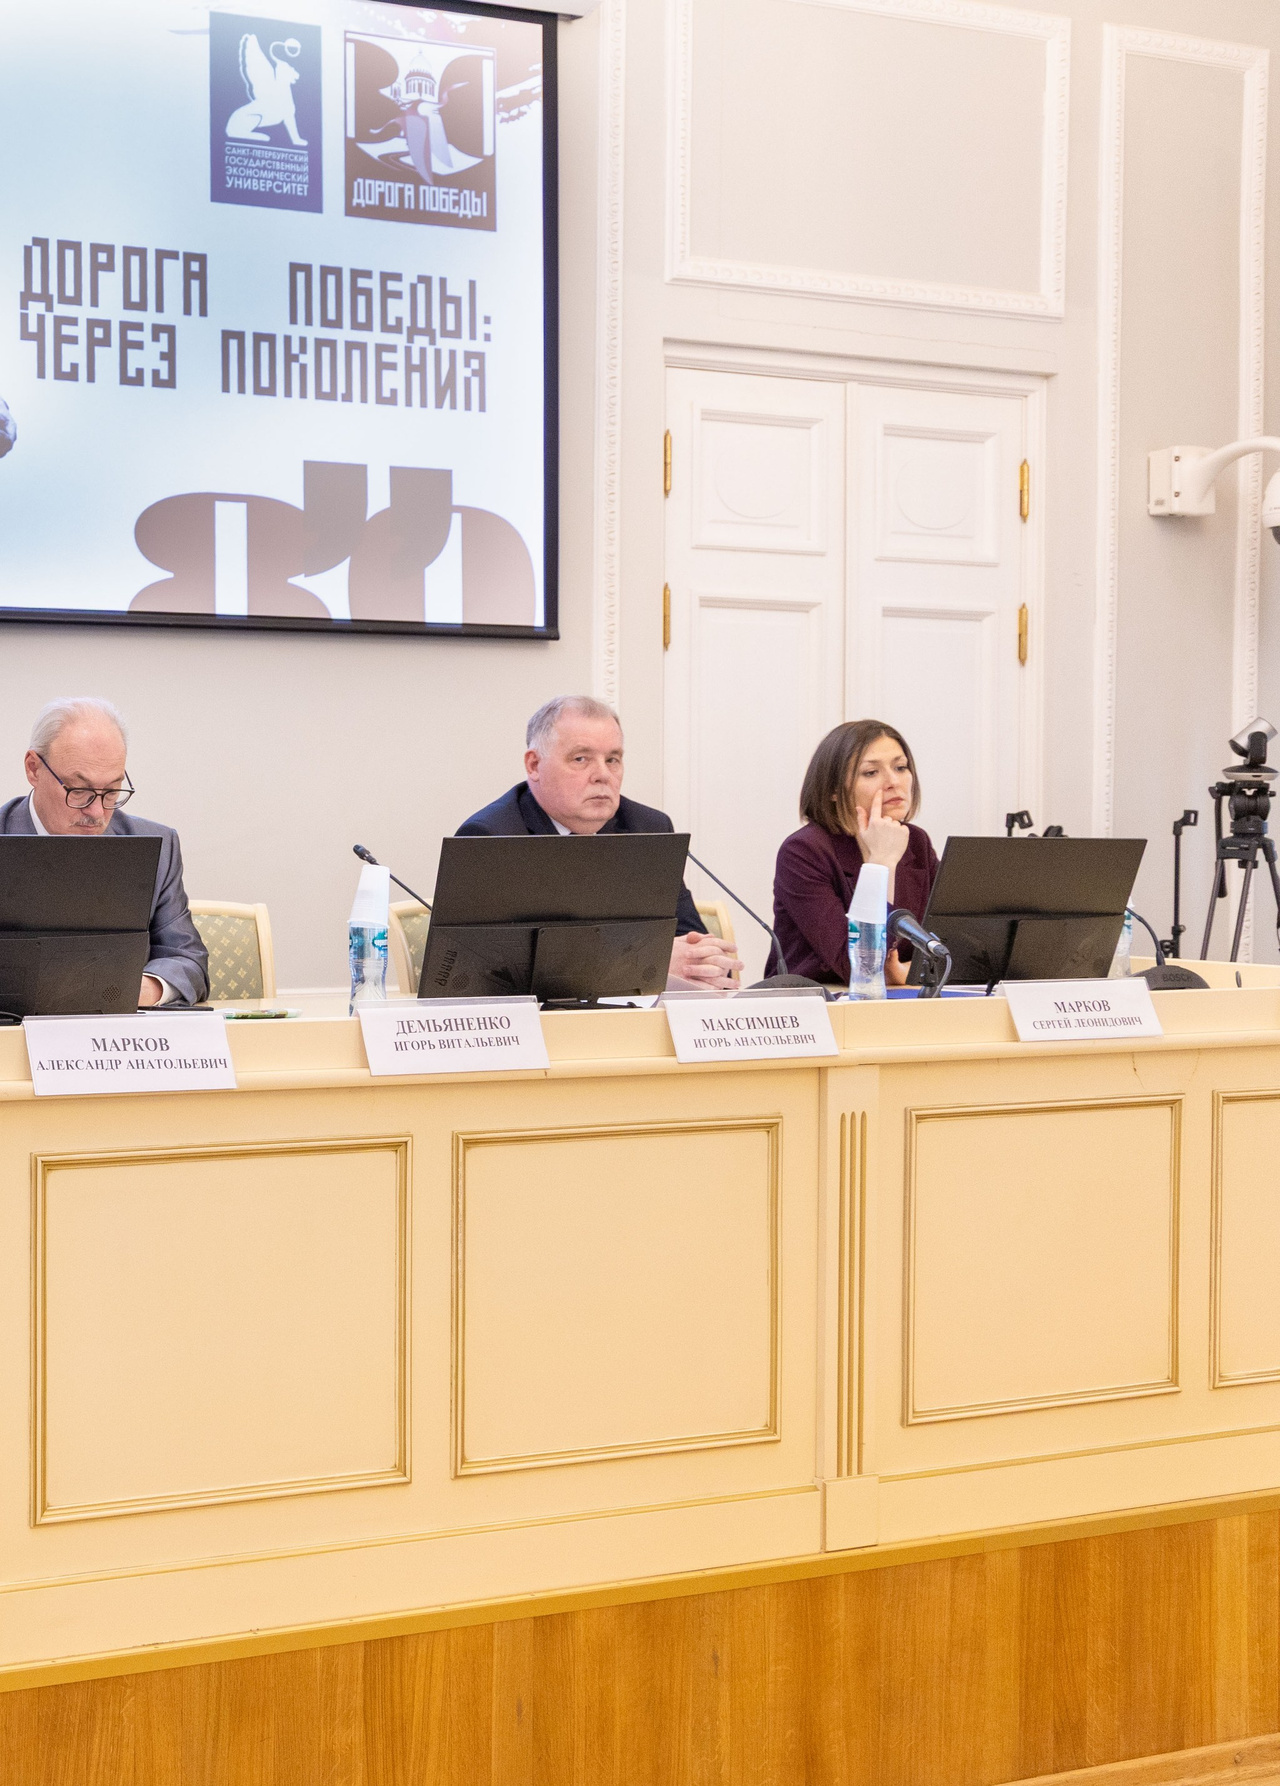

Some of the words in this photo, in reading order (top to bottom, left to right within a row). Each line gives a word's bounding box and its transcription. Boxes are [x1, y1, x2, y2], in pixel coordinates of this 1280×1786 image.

[225, 146, 309, 163] САНКТ-ПЕТЕРБУРГСКИЙ
[225, 155, 309, 173] ГОСУДАРСТВЕННЫЙ
[225, 165, 309, 183] ЭКОНОМИЧЕСКИЙ
[225, 176, 309, 197] УНИВЕРСИТЕТ
[352, 177, 415, 210] ДОРОГА
[418, 184, 487, 219] ПОБЕДЫ
[19, 236, 209, 318] ДОРОГА
[288, 261, 492, 346] ПОБЕДЫ:
[19, 311, 177, 390] ЧЕРЕЗ
[220, 328, 487, 413] ПОКОЛЕНИЯ
[1053, 999, 1111, 1014] МАРКОВ
[395, 1015, 512, 1037] ДЕМЬЯНЕНКО
[700, 1015, 800, 1032] МАКСИМЦЕВ
[1032, 1016, 1072, 1031] СЕРГЕЙ
[1073, 1015, 1144, 1029] ЛЕОНИДОВИЧ
[90, 1036, 171, 1053] МАРКОВ
[393, 1039, 436, 1052] ИГОРЬ
[438, 1035, 521, 1051] ВИТАЛЬЕВИЧ
[693, 1037, 731, 1049] ИГОРЬ
[734, 1033, 817, 1048] АНАТОЛЬЕВИЧ
[36, 1058, 122, 1072] АЛЕКСАНДР
[126, 1057, 229, 1071] АНАТОЛЬЕВИЧ
